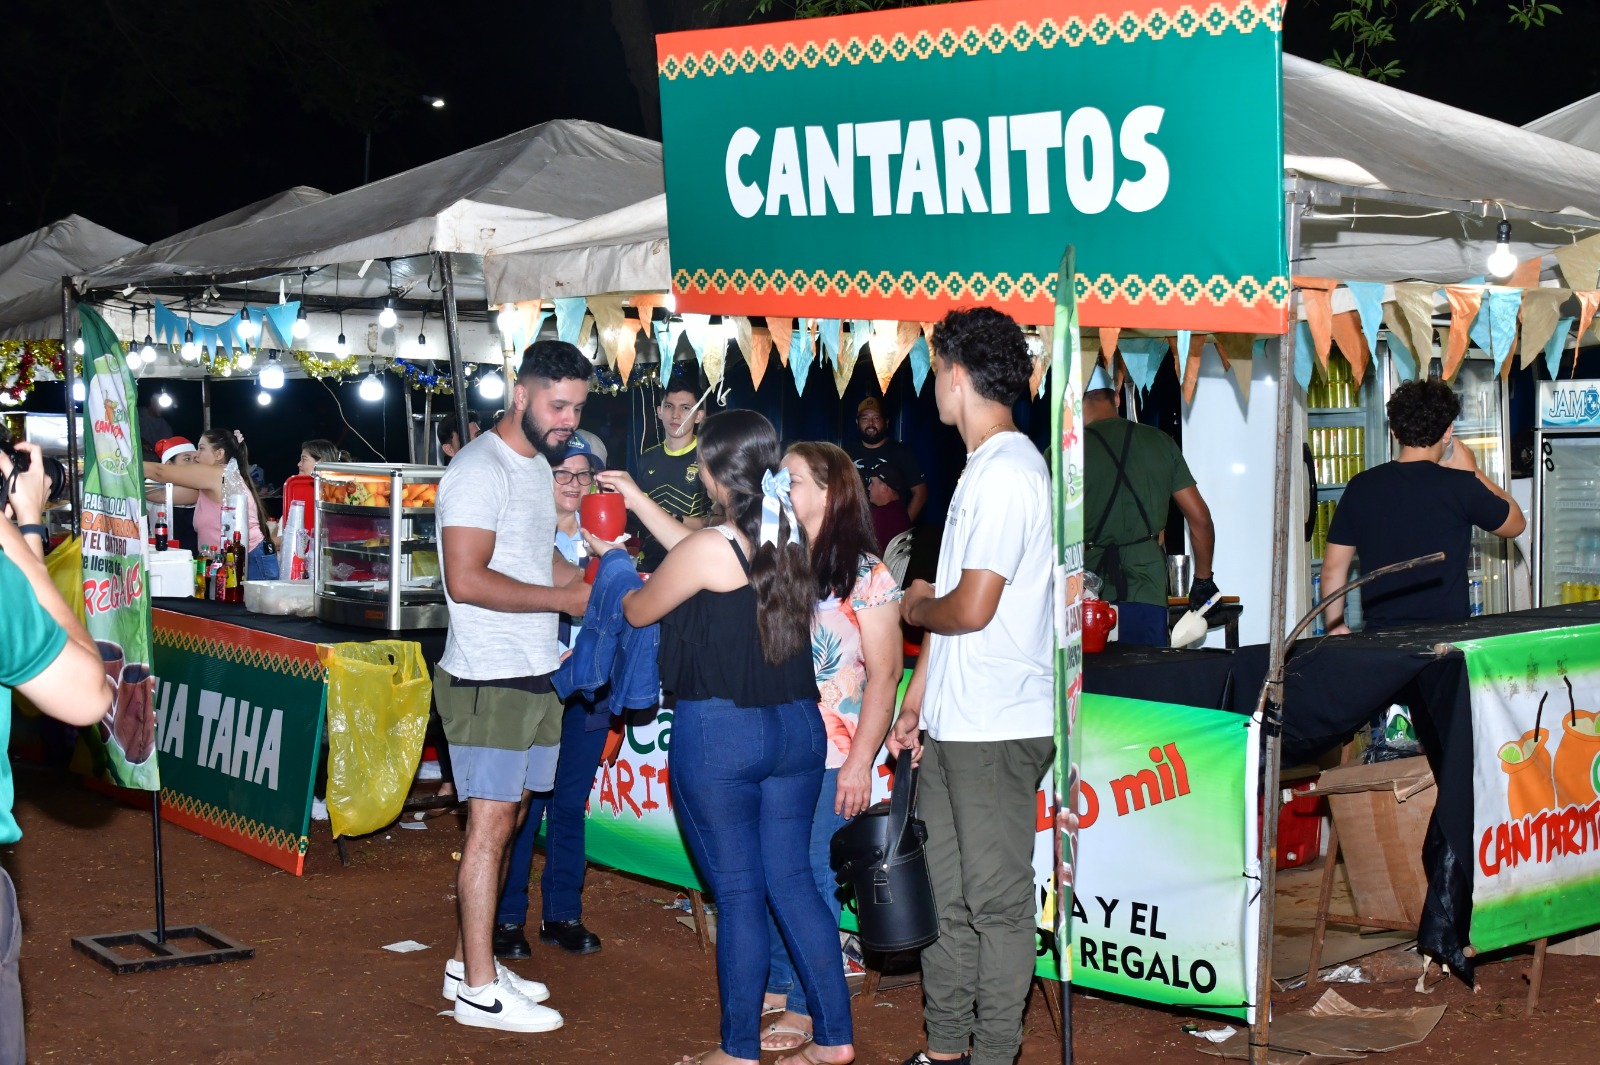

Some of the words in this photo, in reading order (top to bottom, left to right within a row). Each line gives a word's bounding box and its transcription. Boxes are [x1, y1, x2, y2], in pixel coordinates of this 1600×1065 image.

[725, 105, 1170, 218] CANTARITOS
[82, 531, 88, 547] Y
[90, 533, 102, 550] EL
[155, 676, 188, 759] HA
[197, 689, 283, 791] TAHA
[627, 712, 673, 754] Ca
[1109, 742, 1191, 817] mil
[1479, 800, 1600, 877] CANTARIT
[1095, 896, 1119, 928] Y
[1131, 902, 1166, 940] EL
[1080, 936, 1217, 994] REGALO
